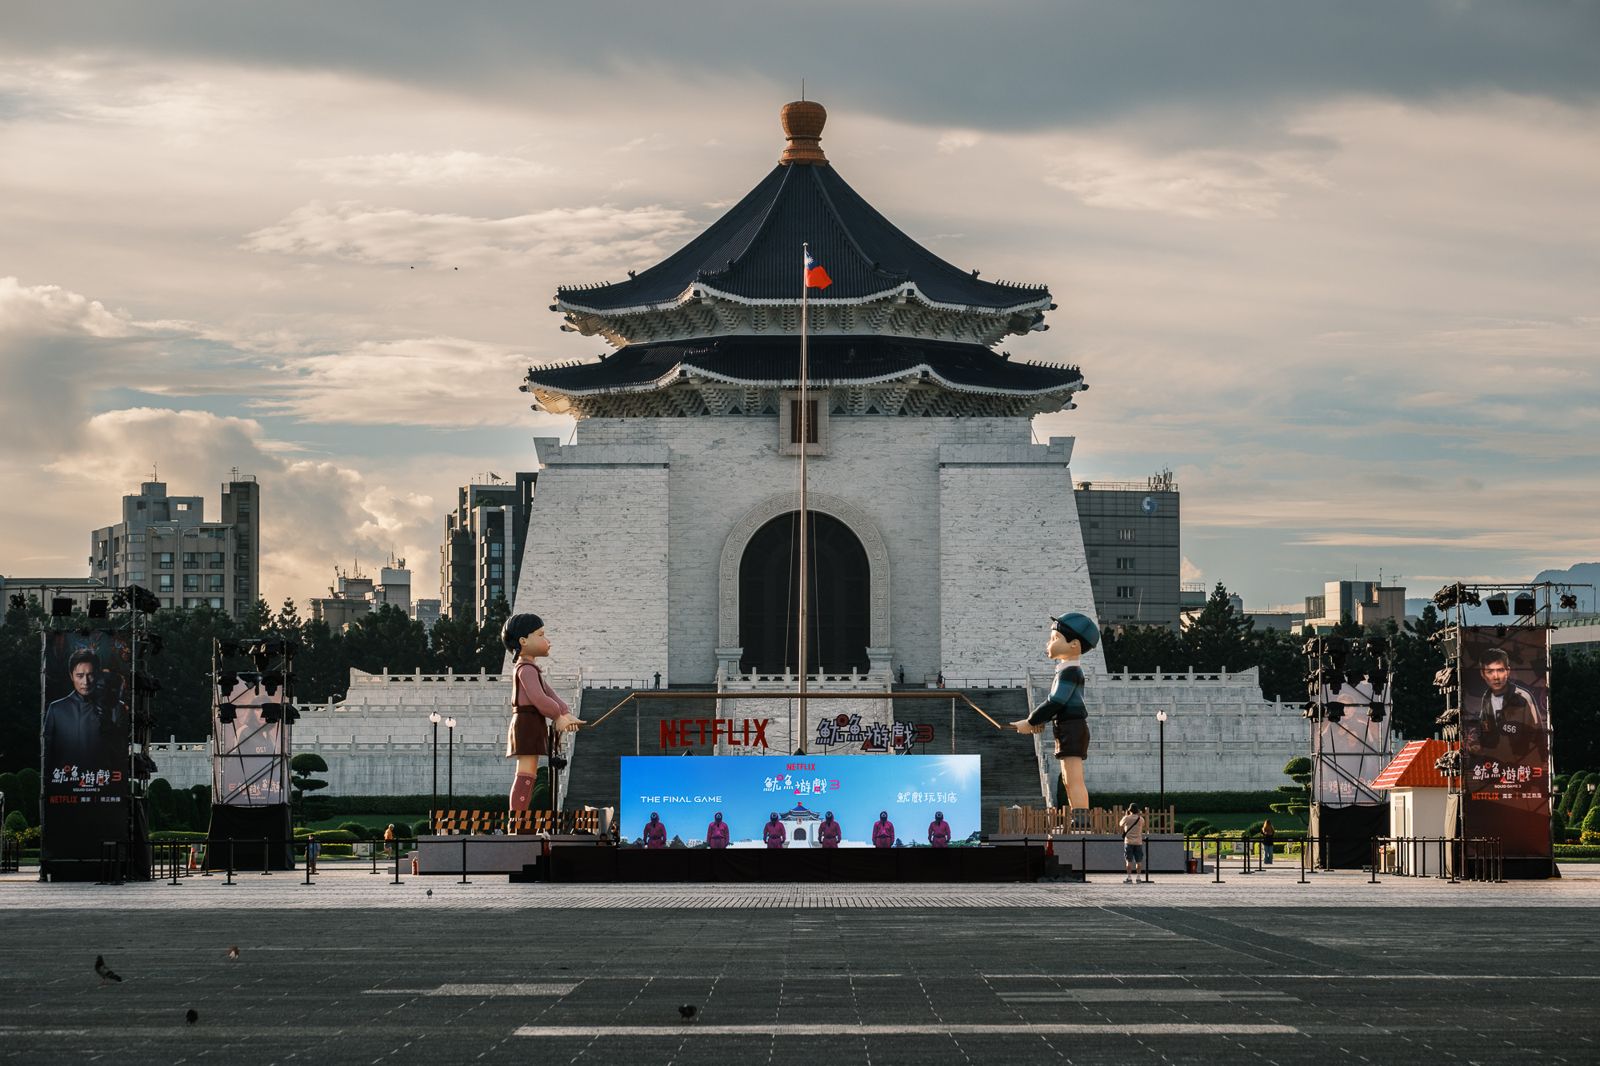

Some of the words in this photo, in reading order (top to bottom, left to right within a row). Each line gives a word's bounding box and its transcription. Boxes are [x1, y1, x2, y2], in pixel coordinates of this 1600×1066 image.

[660, 718, 769, 748] NETFLIX
[1502, 724, 1517, 734] 456
[786, 763, 816, 771] NETFLIX
[693, 795, 722, 803] GAME
[1472, 792, 1499, 800] NETFLIX
